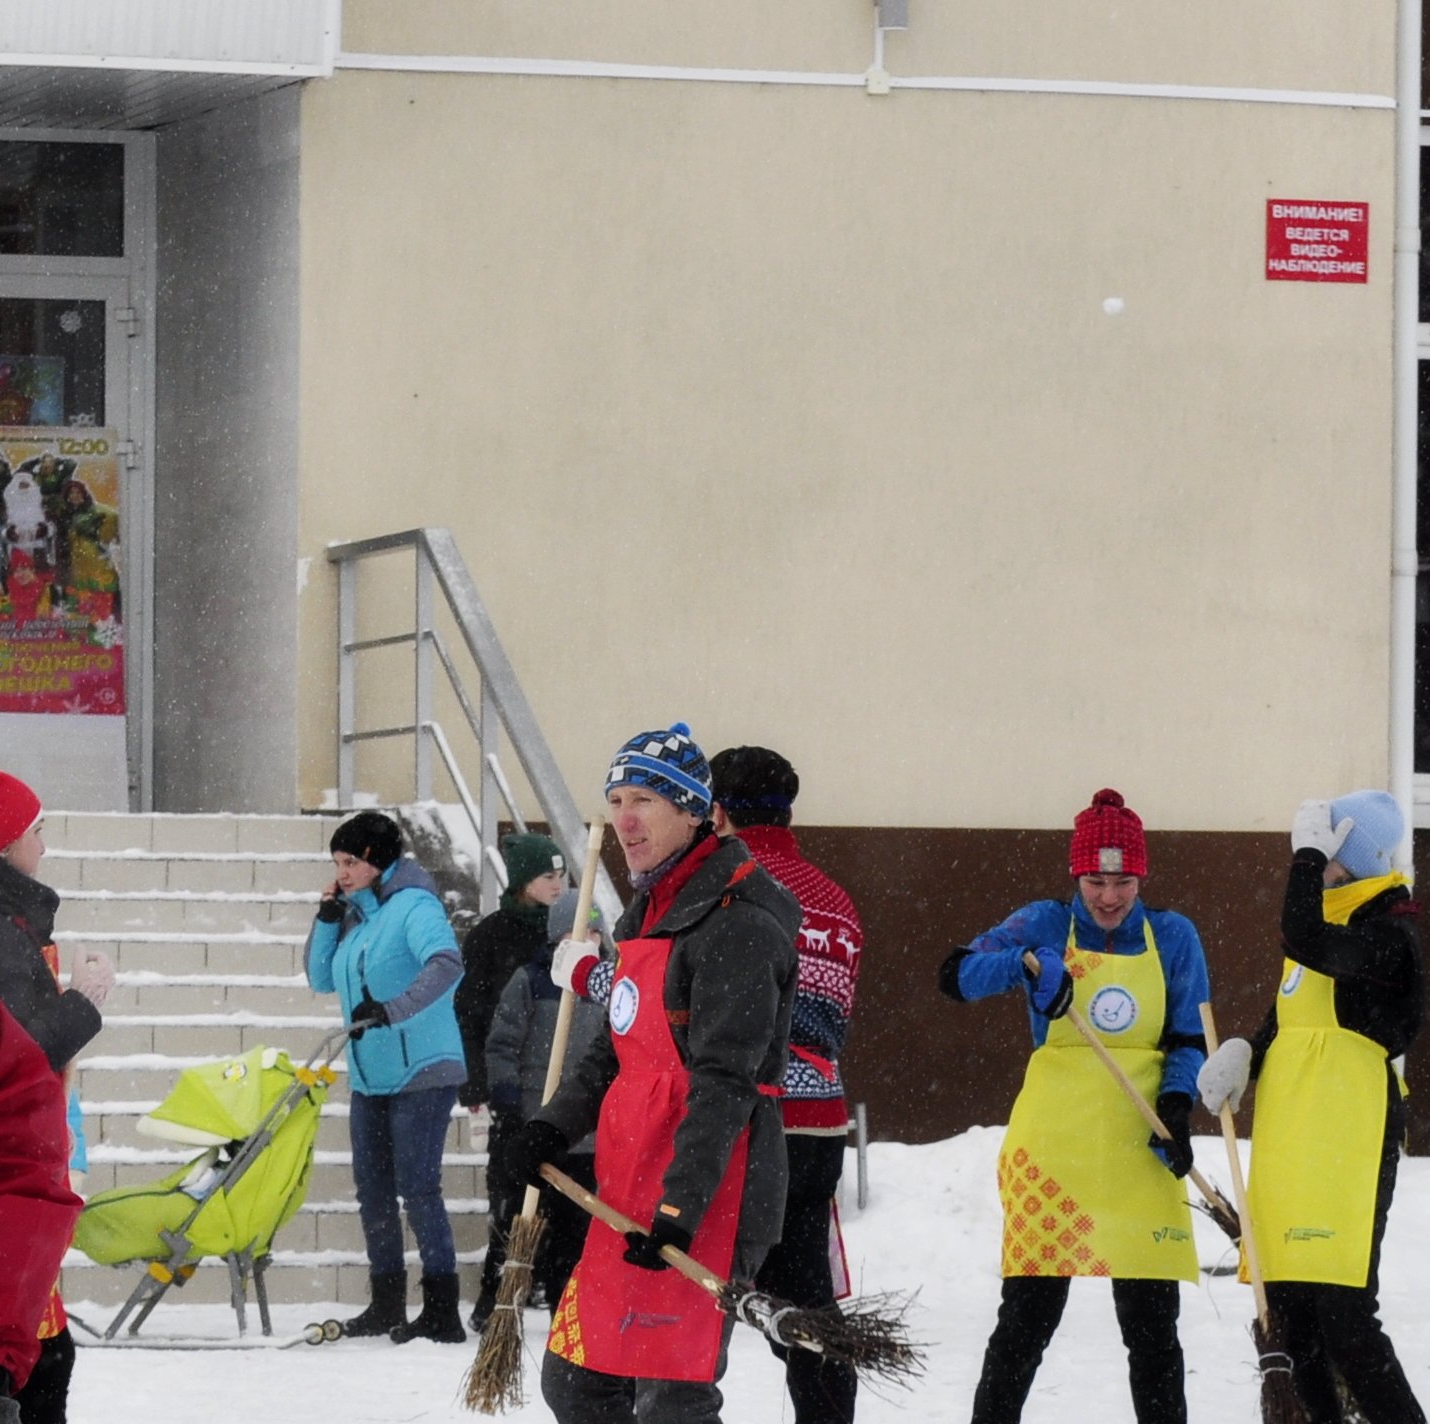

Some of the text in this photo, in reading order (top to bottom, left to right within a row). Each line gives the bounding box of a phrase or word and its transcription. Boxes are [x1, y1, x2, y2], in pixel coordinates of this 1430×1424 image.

[1272, 204, 1363, 221] ВНИМАНИЕ!
[1286, 227, 1349, 241] ВЕДЕТСЯ
[1290, 244, 1343, 257] ВИДЕО-
[1269, 259, 1365, 274] НАБЛЮДЕНИЕ
[59, 438, 109, 455] 12:00
